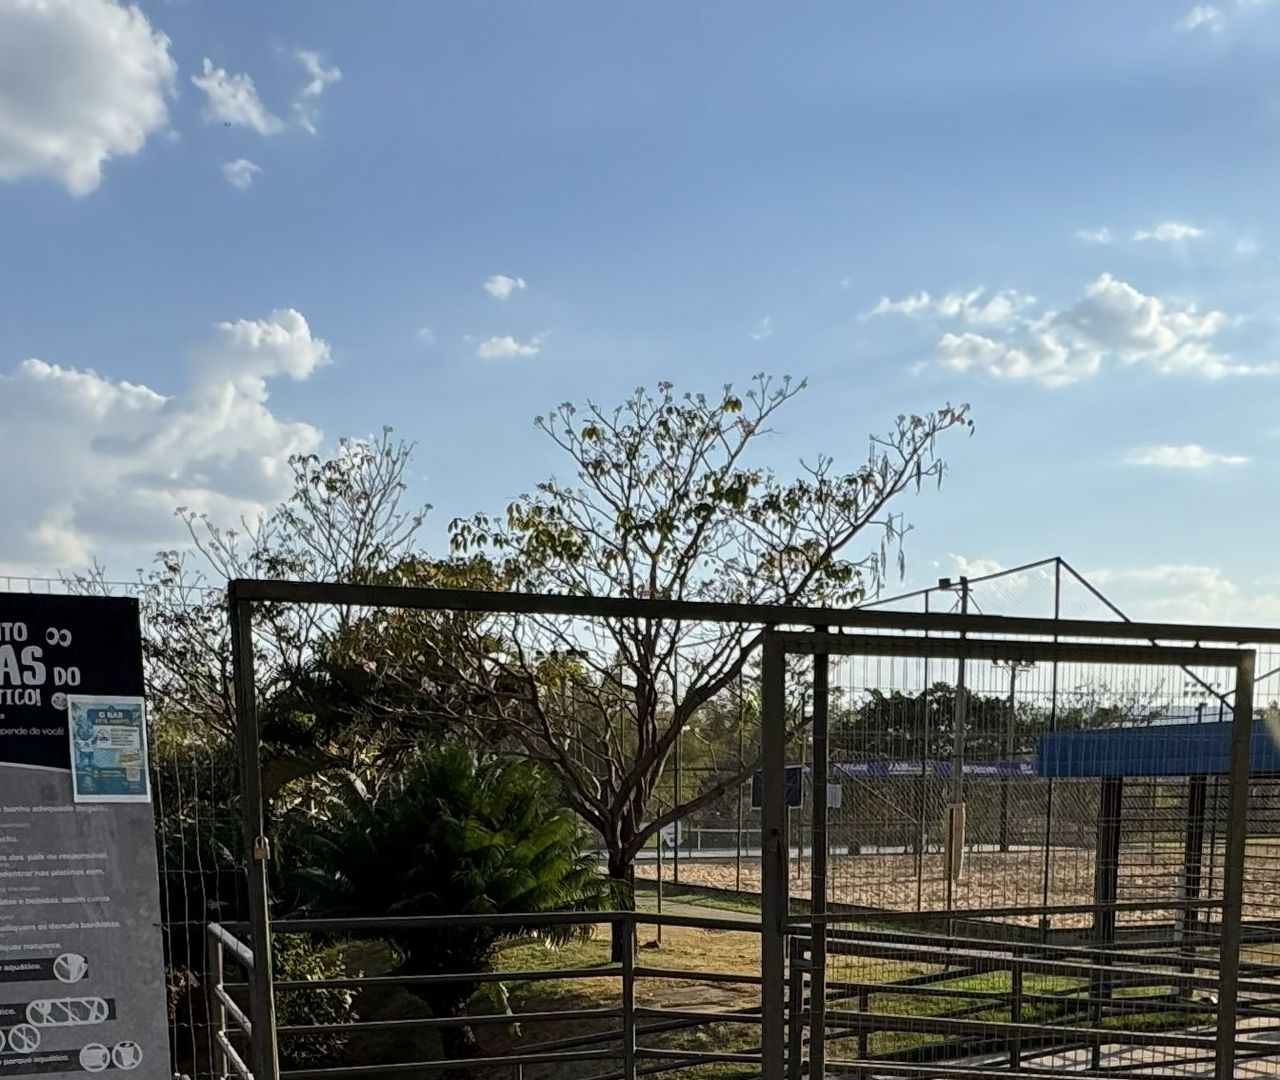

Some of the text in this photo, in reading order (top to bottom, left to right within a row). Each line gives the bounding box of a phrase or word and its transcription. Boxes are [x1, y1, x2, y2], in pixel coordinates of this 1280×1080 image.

[53, 666, 81, 686] DO
[29, 727, 41, 735] de
[3, 1057, 32, 1066] parque
